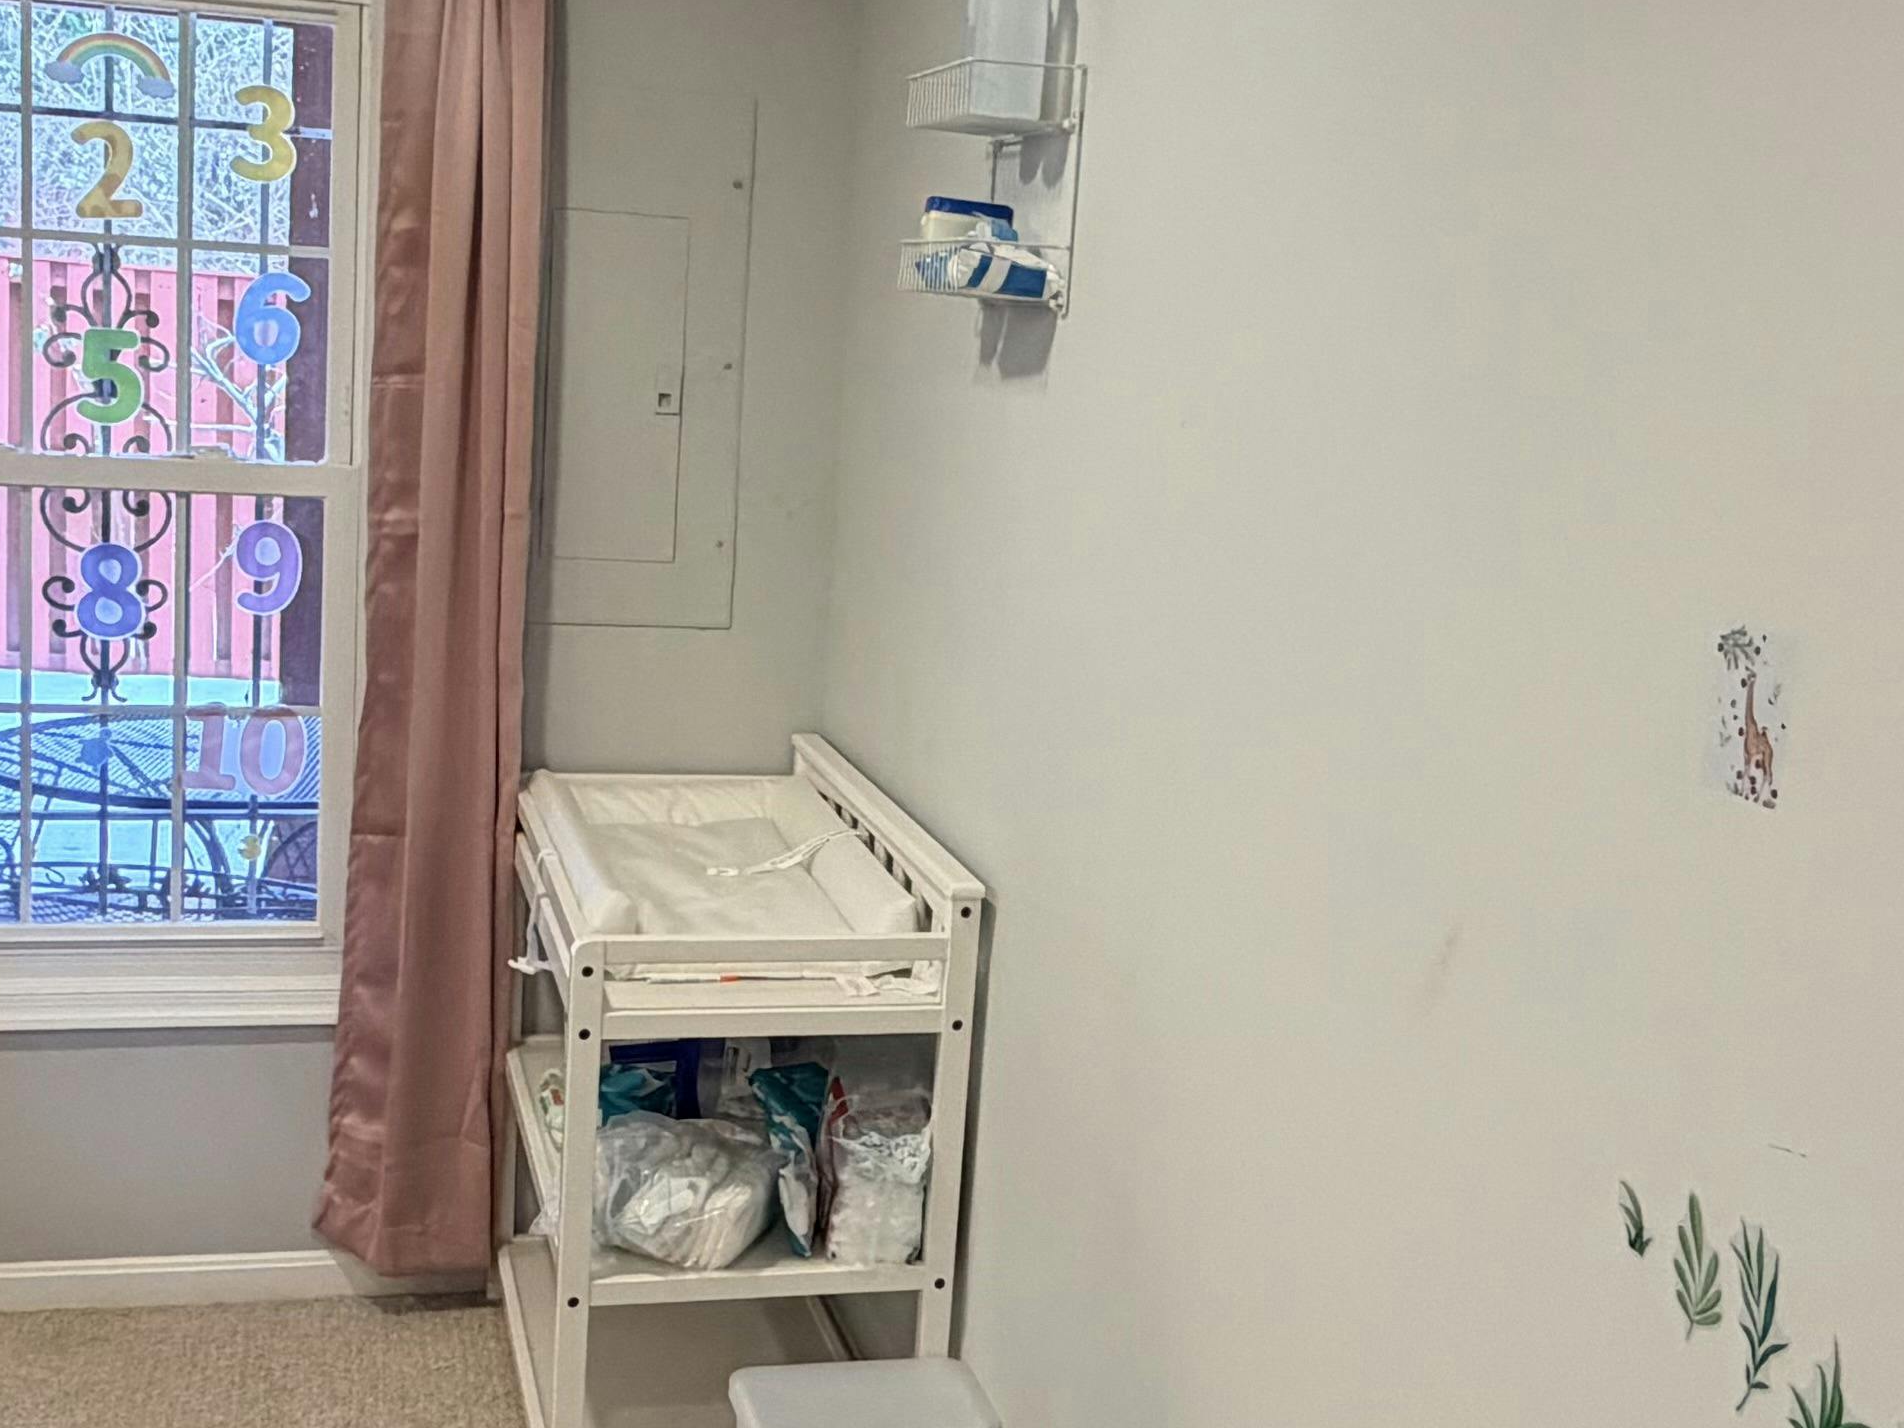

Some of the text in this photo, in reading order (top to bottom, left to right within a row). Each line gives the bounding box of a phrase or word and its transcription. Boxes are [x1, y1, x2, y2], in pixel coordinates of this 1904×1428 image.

[70, 121, 143, 218] 2
[230, 84, 297, 182] 3
[234, 272, 312, 365] 6
[75, 327, 142, 424] 5
[74, 541, 144, 640] 8
[235, 519, 303, 616] 9
[180, 702, 306, 796] 10
